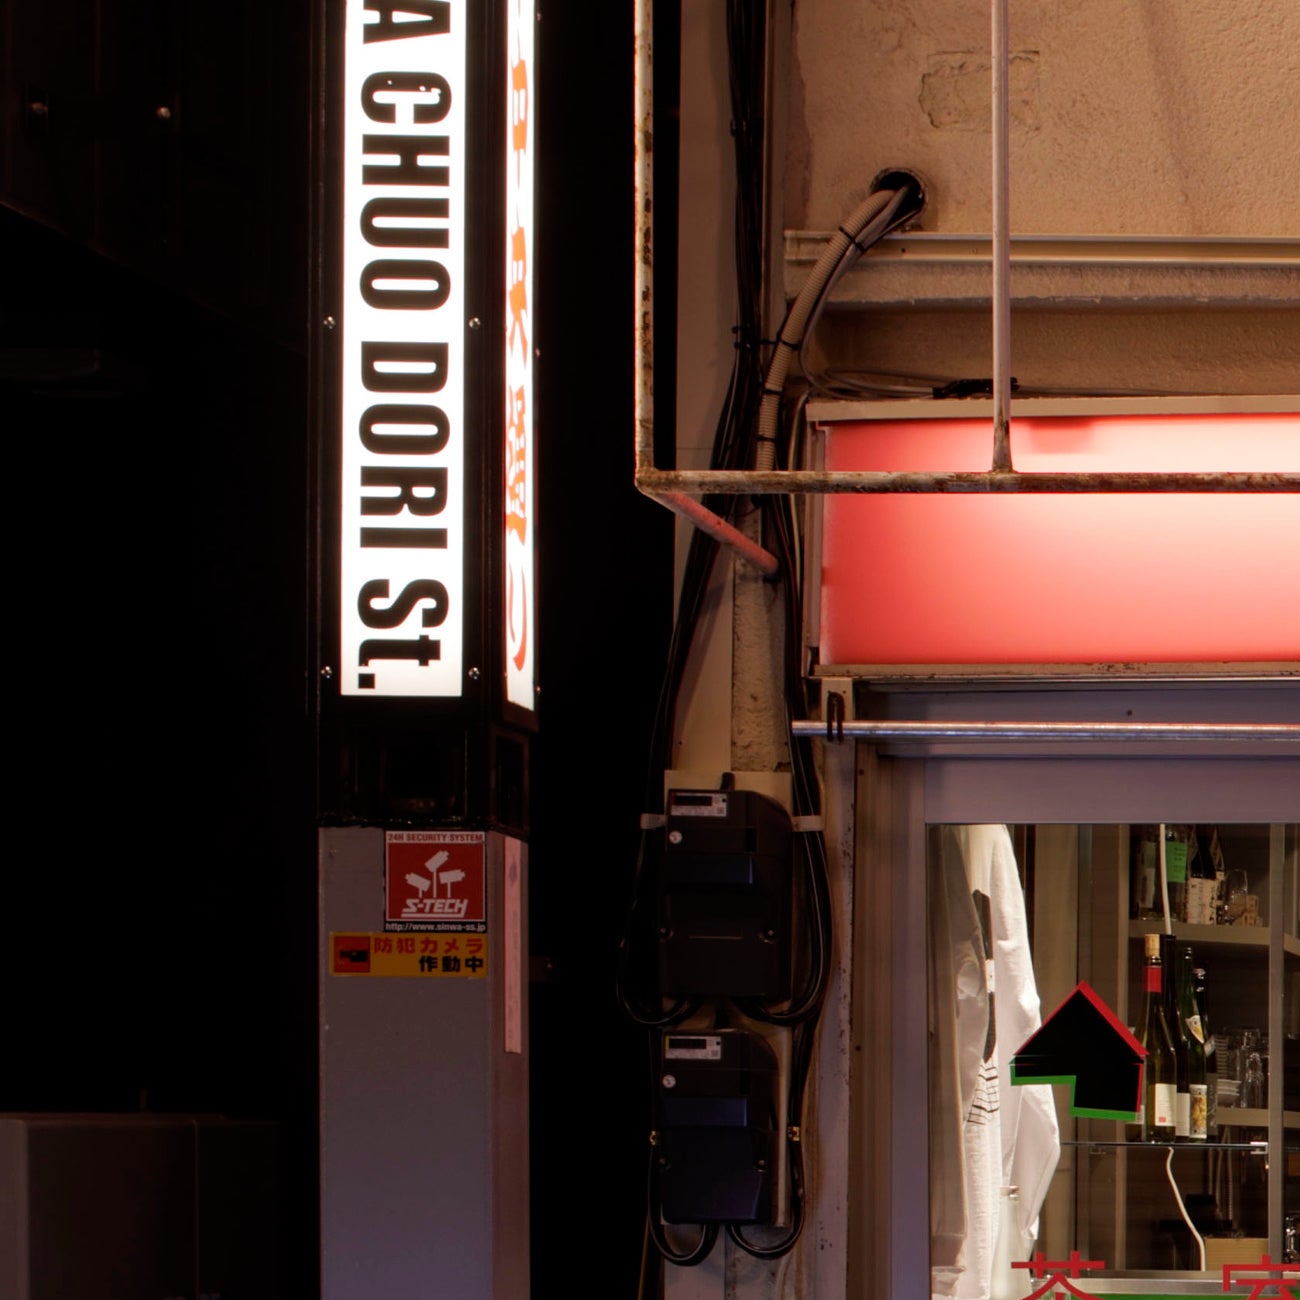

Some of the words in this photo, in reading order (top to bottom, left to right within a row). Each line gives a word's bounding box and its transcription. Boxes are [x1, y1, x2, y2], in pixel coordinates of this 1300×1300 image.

[361, 71, 452, 311] CHUO
[505, 0, 529, 671] 中央通り
[358, 341, 451, 550] DORI
[357, 577, 450, 690] St.
[388, 833, 404, 842] 24H
[406, 832, 448, 843] SECURITY
[449, 833, 483, 843] SYSTEM
[401, 898, 469, 918] S-TECH
[374, 937, 484, 954] 防犯カメラ
[418, 955, 484, 973] 作動中
